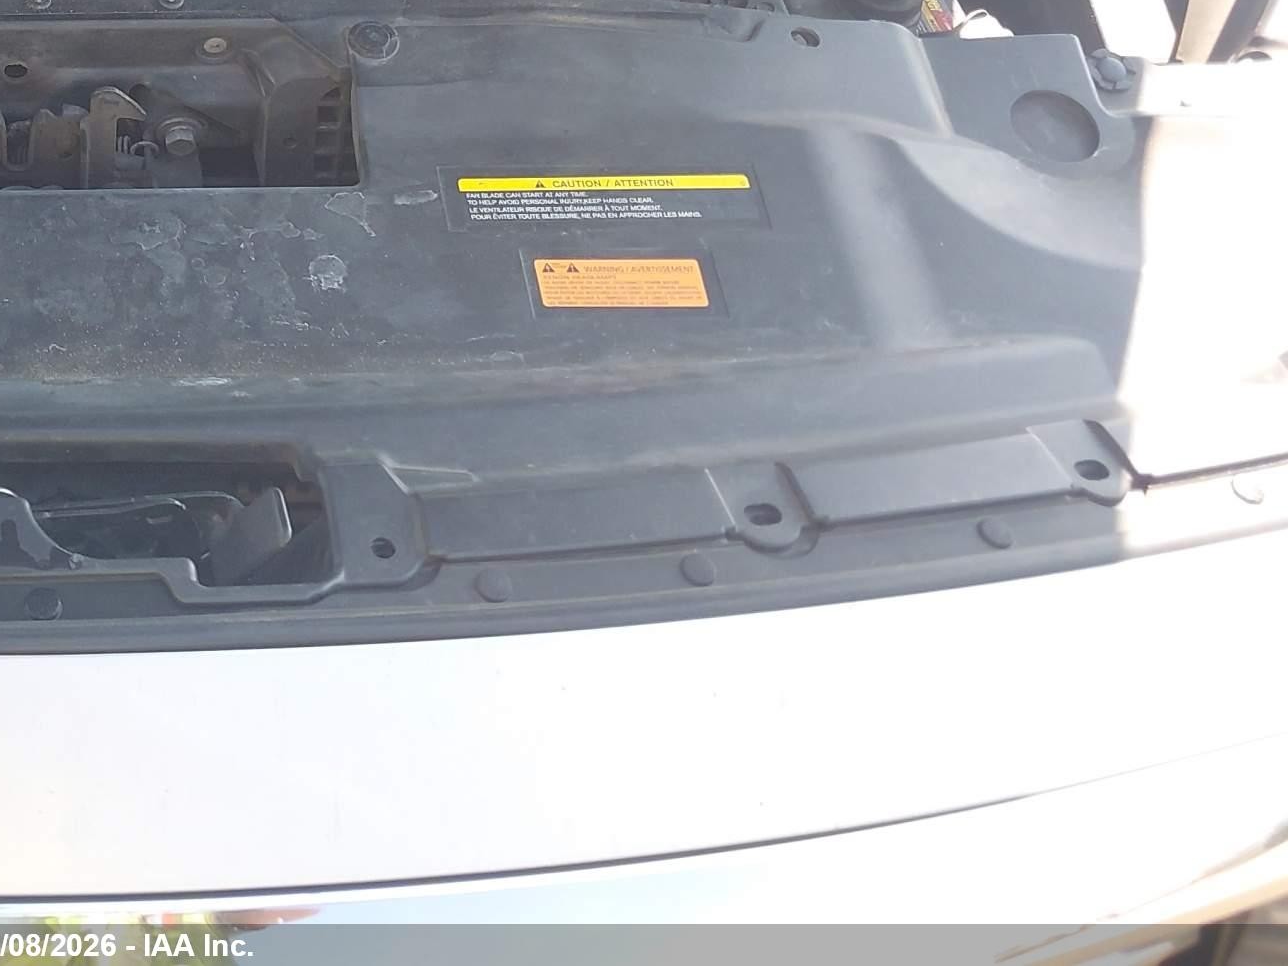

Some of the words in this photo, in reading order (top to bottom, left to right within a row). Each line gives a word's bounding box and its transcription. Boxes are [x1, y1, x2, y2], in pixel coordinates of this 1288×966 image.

[552, 179, 601, 188] CAUTION
[614, 178, 674, 187] ATTENTION
[564, 204, 603, 212] DÉMARRER
[583, 265, 624, 274] WARNING
[630, 265, 694, 274] AVERTISSEMENT
